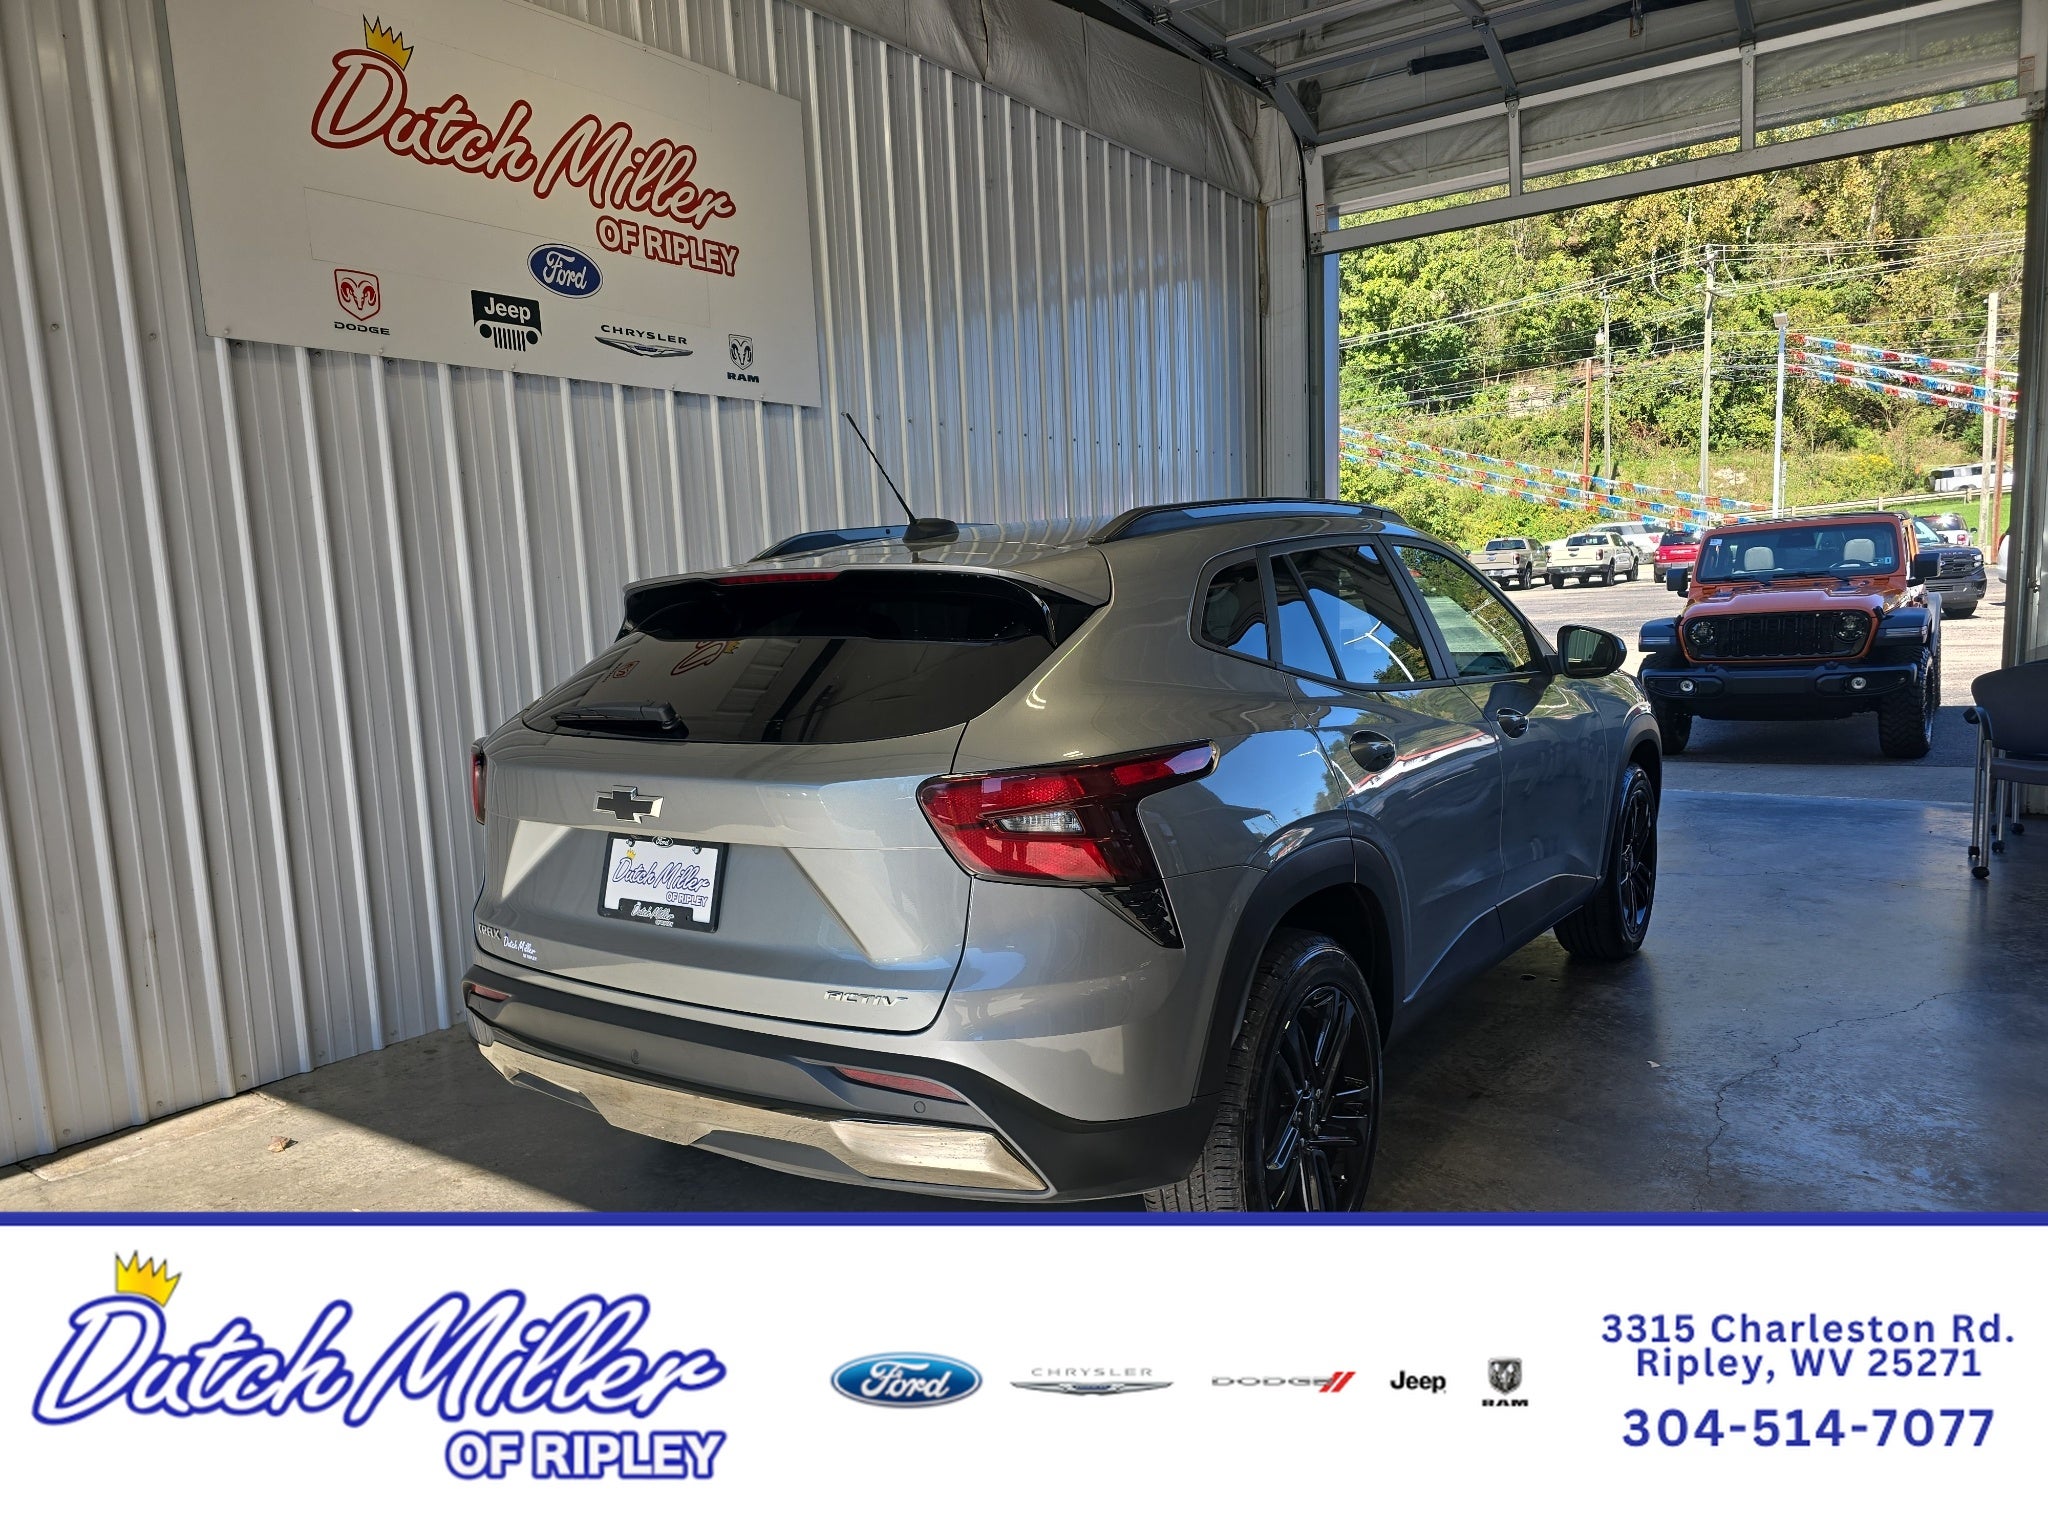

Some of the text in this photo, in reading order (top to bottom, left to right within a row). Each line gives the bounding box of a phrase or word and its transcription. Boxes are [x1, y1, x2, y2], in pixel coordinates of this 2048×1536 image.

[311, 49, 736, 229] Dutch Miller
[597, 216, 739, 277] OF RIPLEY
[543, 247, 588, 291] Ford
[483, 296, 531, 324] Jeep
[333, 321, 390, 336] DODGE
[600, 324, 688, 345] CHRYSLER
[726, 371, 760, 383] RAM
[655, 836, 670, 847] Ford
[612, 857, 711, 892] Dutch Miller
[666, 891, 708, 907] OF RIPLEY
[824, 990, 908, 1006] ACTIV
